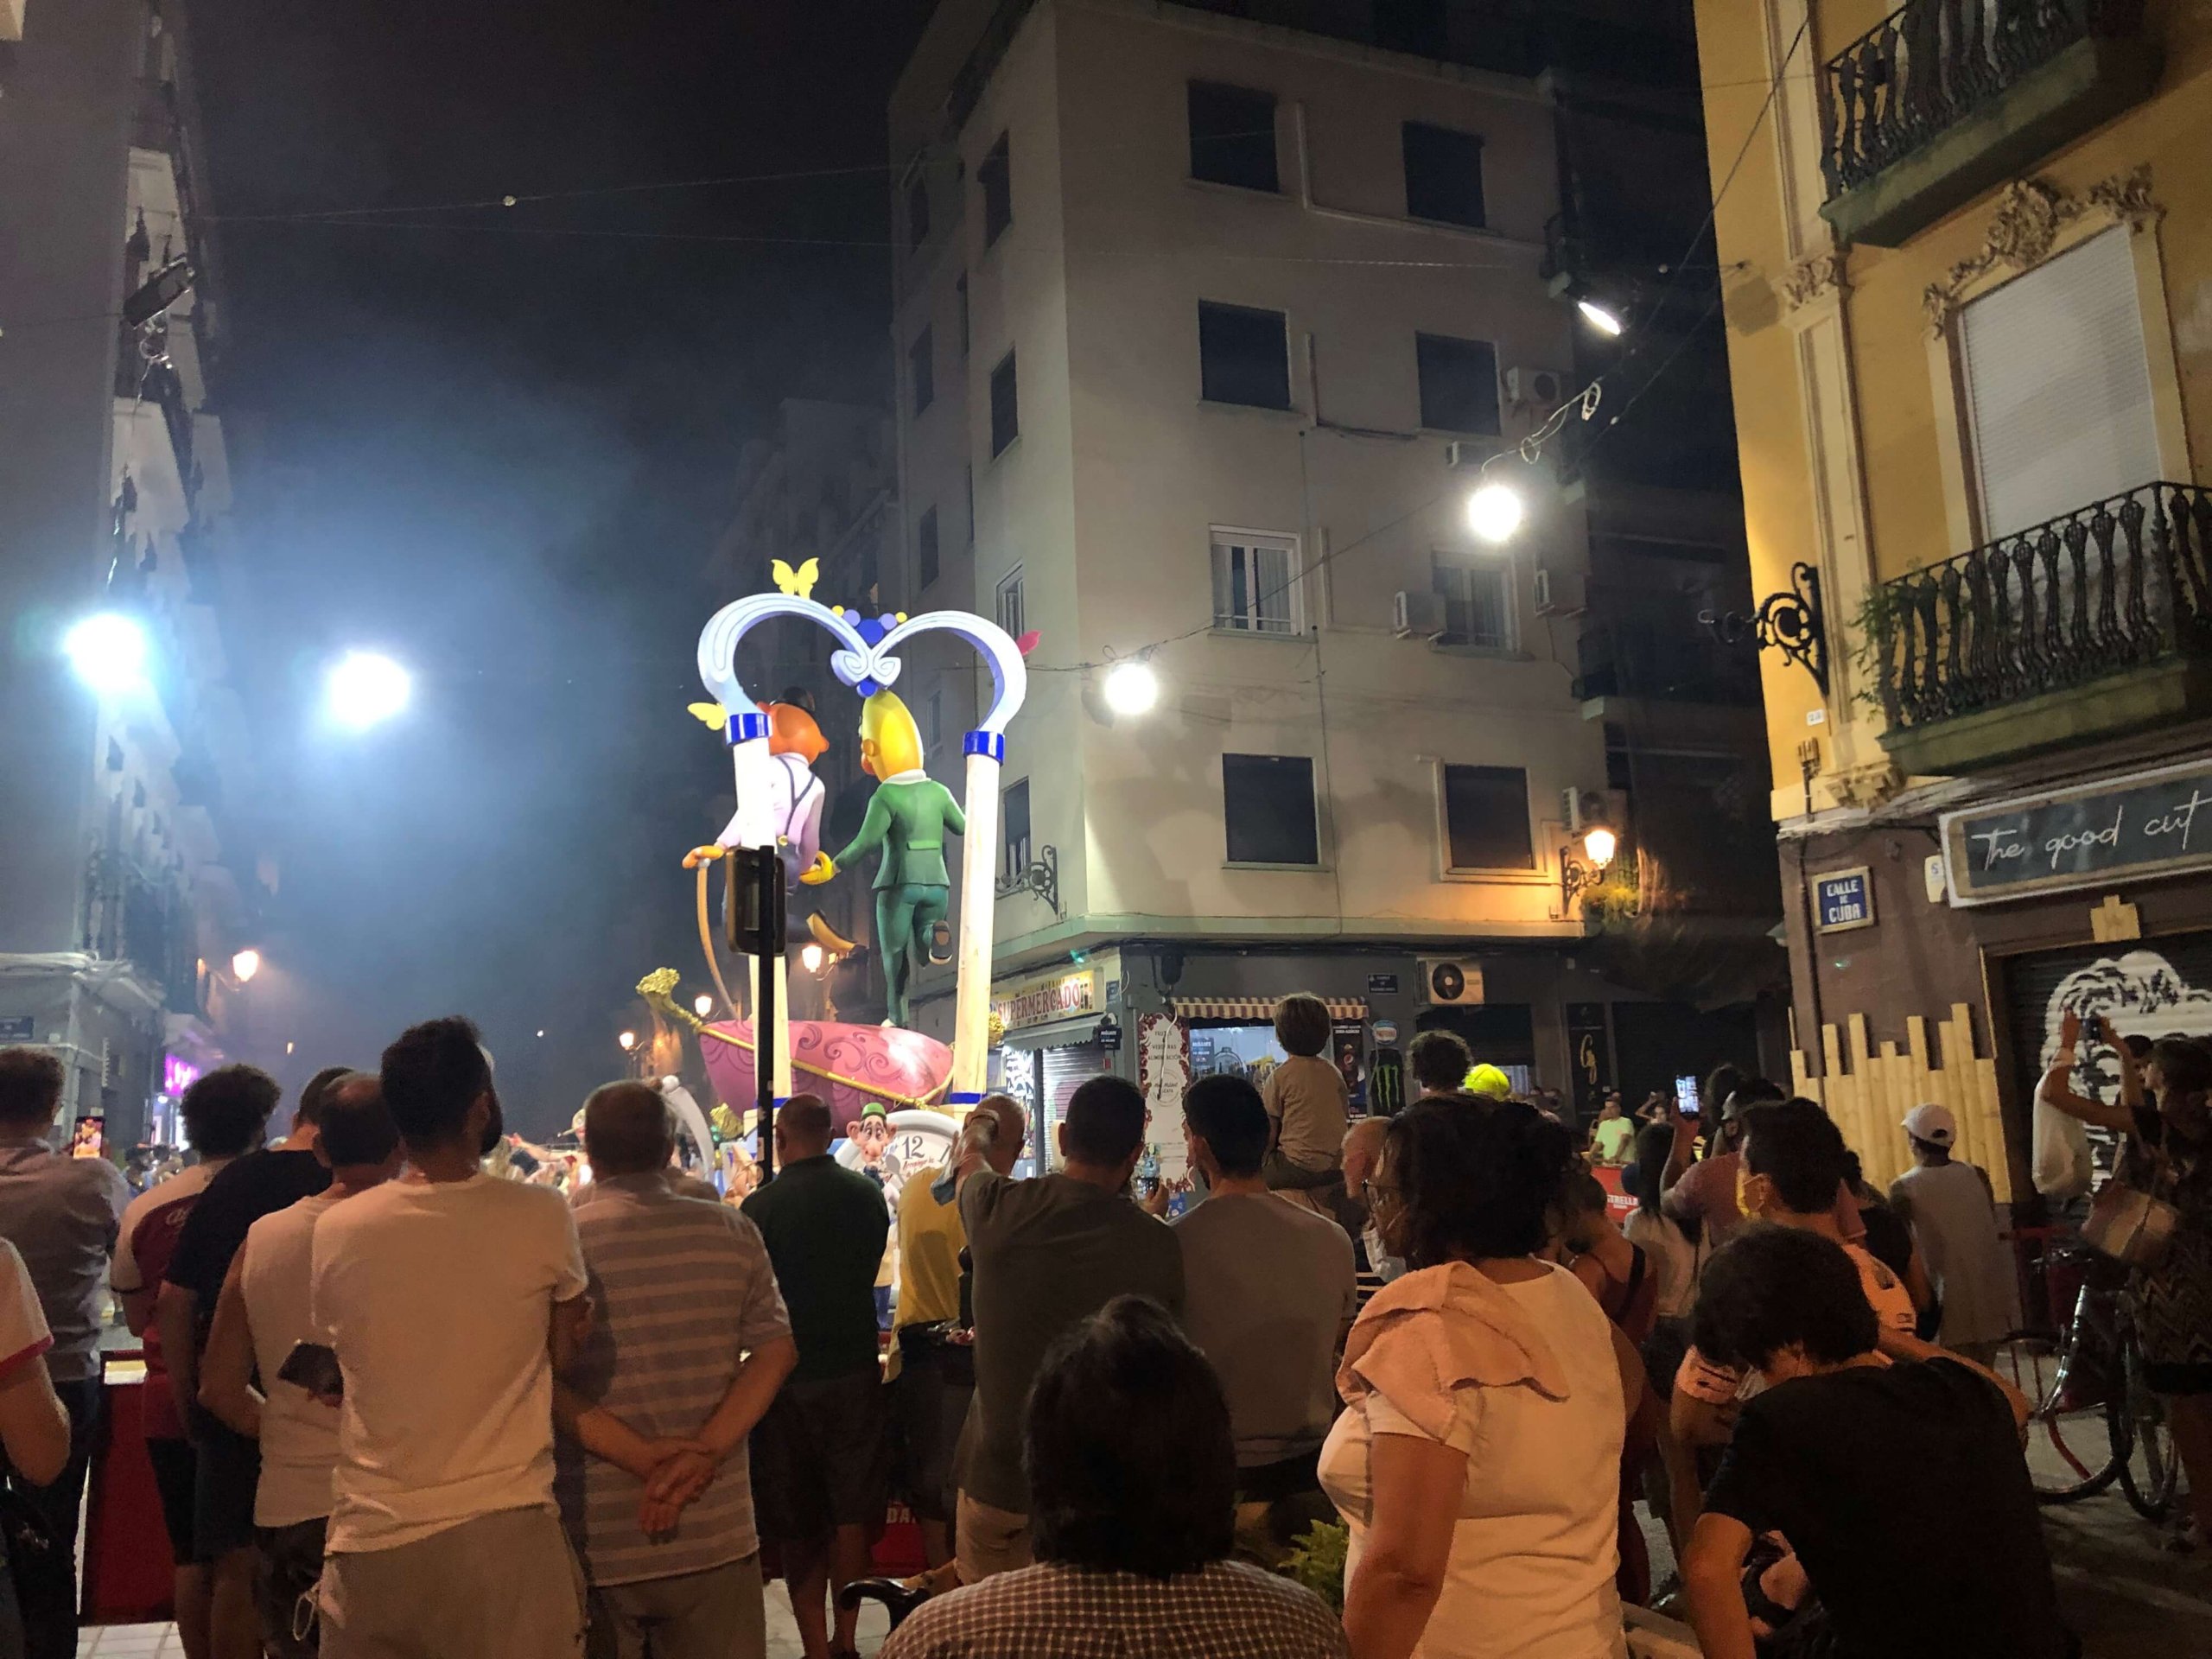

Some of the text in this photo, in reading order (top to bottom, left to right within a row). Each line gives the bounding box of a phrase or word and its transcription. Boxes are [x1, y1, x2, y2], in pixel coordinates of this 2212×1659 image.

[1971, 790, 2212, 872] The good cut
[1826, 879, 1859, 898] CALLE
[1828, 904, 1861, 924] CUBA
[997, 982, 1081, 1023] SUPERMERCADO
[902, 1135, 925, 1160] 12
[1607, 1194, 1638, 1206] STRELLA
